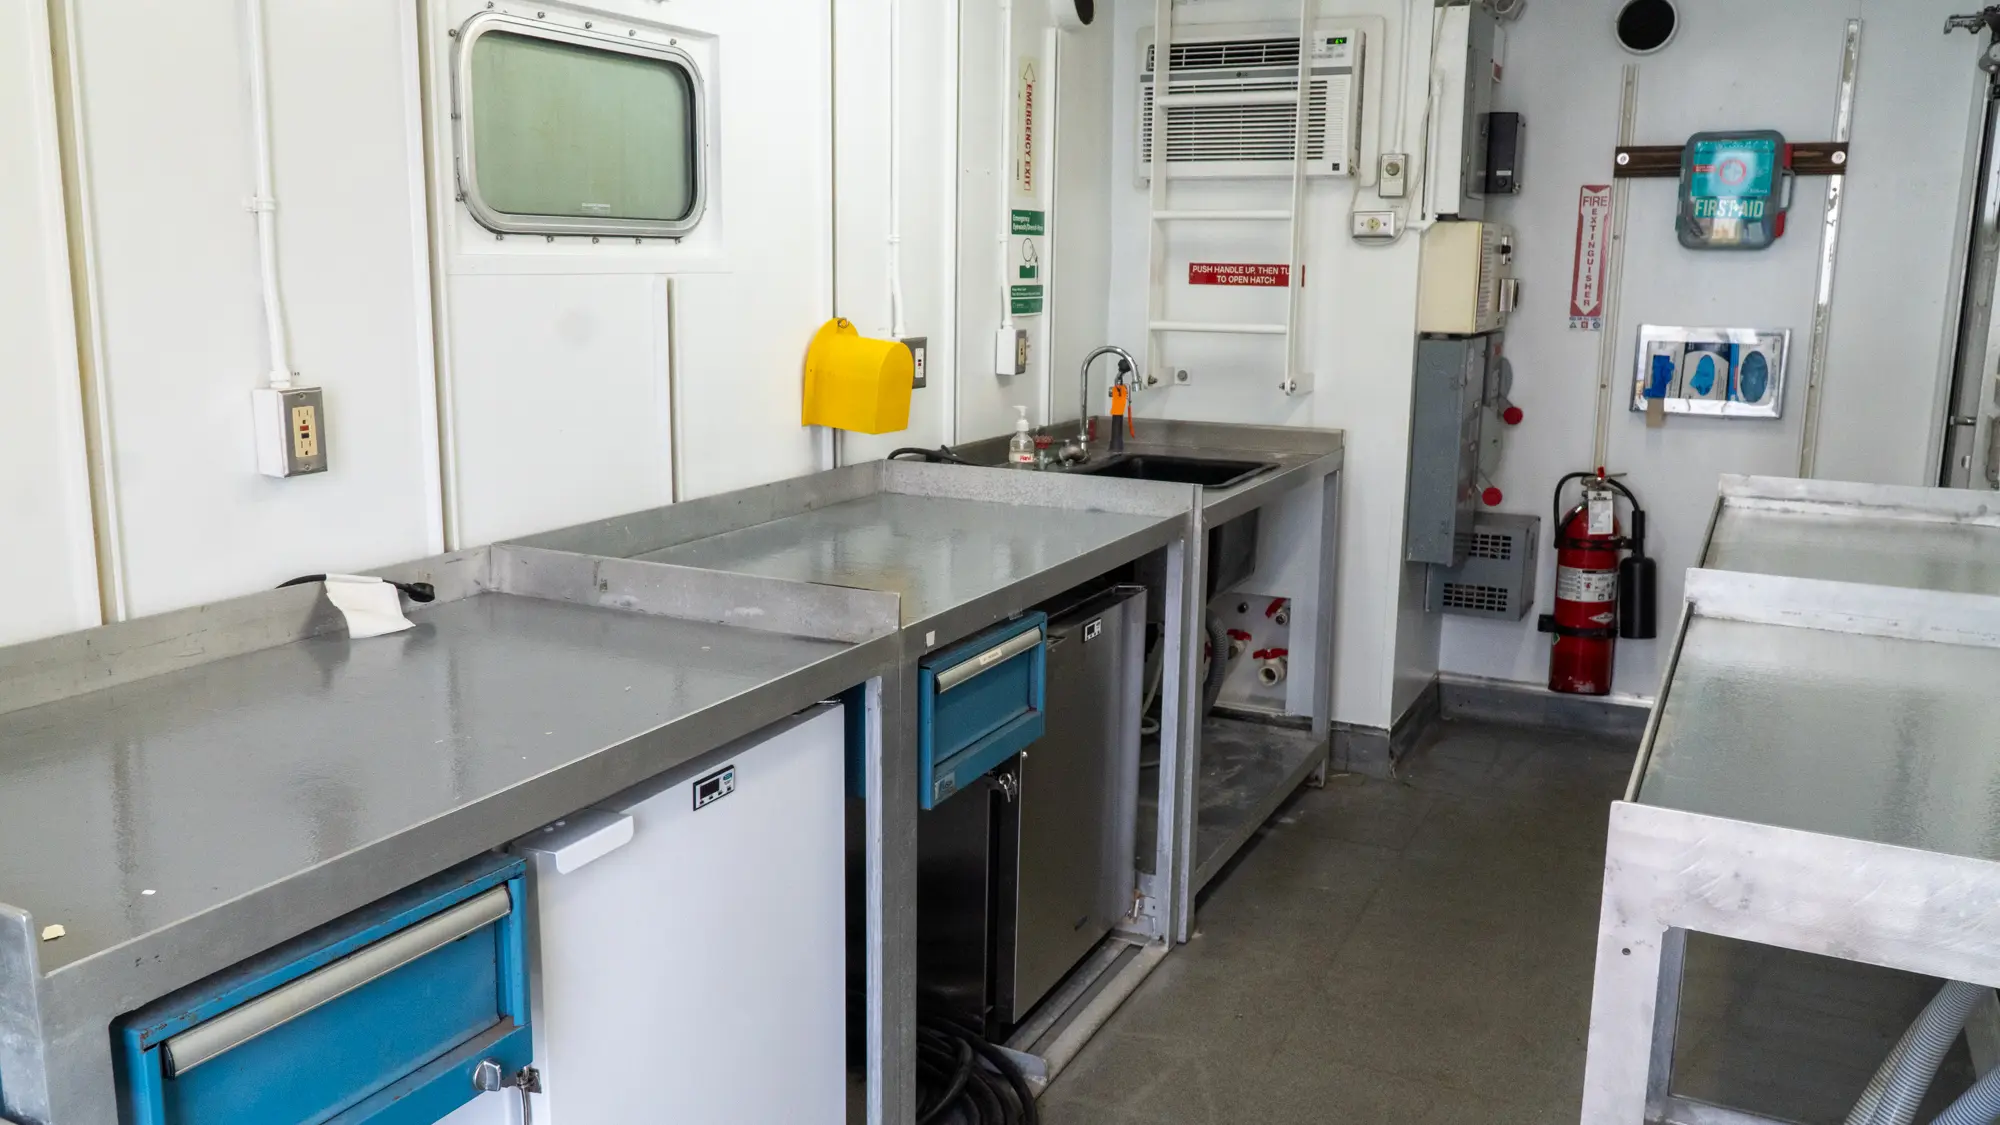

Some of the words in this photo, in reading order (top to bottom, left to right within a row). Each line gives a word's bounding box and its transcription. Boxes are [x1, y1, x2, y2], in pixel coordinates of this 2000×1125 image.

[1025, 84, 1033, 157] EMERGENCY
[1582, 195, 1608, 207] FIRE
[1695, 199, 1736, 217] FIRST
[1739, 200, 1764, 217] AID
[1012, 214, 1030, 223] Emergency
[1583, 208, 1598, 307] EXTINGUISHER
[1192, 265, 1213, 273] PUSH
[1214, 266, 1244, 274] HANDLE
[1258, 267, 1279, 275] THEN
[1216, 275, 1227, 283] TO
[1228, 275, 1249, 284] OPEN
[1250, 276, 1276, 284] HATCH
